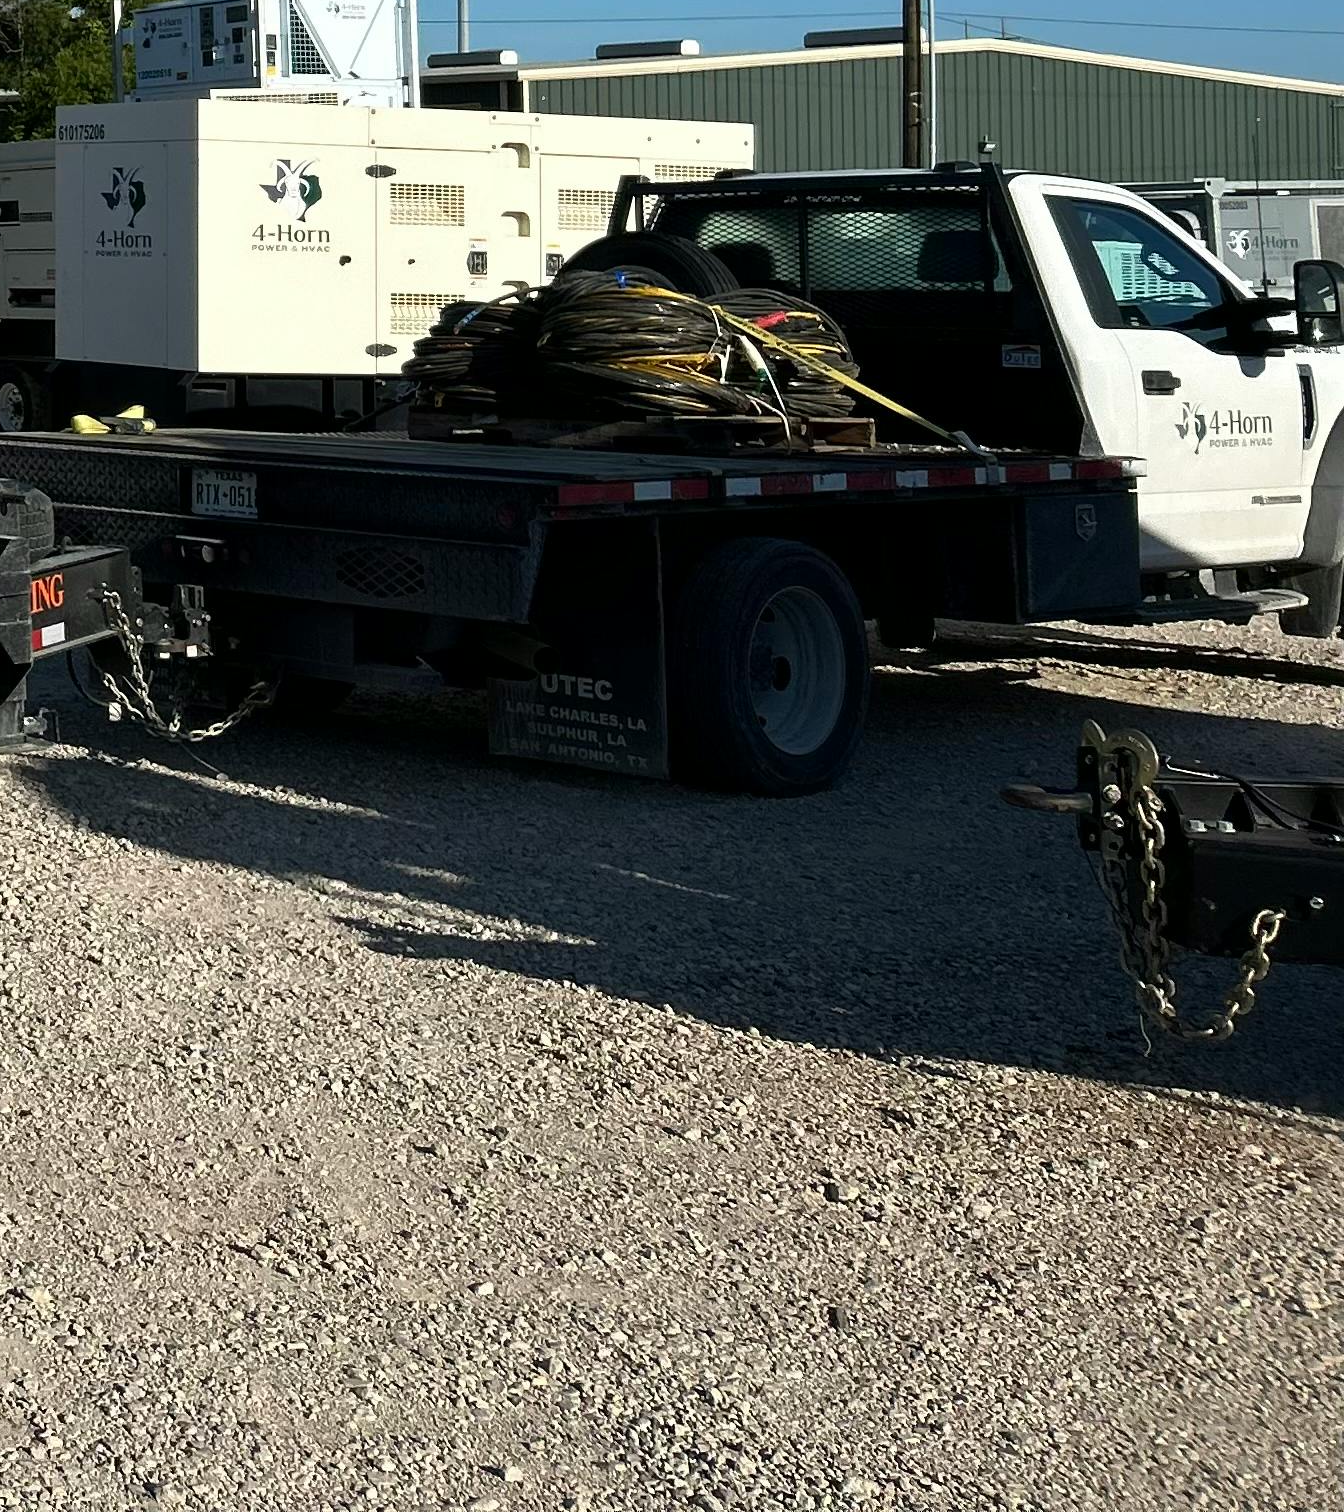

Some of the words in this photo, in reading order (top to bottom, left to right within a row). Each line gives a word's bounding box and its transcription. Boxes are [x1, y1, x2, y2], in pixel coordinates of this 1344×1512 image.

[58, 124, 105, 140] 610175206
[96, 230, 152, 248] 4-Horn
[252, 224, 330, 243] 4-Horn
[1252, 235, 1299, 249] 4-Horn
[1209, 409, 1273, 435] 4-Horn
[1210, 439, 1239, 448] POWER
[1250, 438, 1273, 447] HVAC
[215, 472, 243, 482] TEXAS
[196, 483, 257, 509] RTX-051
[30, 572, 64, 614] ING
[506, 700, 546, 716] LAKE
[550, 706, 623, 730] CHARLES,
[627, 717, 647, 731] LA
[528, 722, 602, 748] SULPHUR,
[607, 733, 627, 747] LA
[510, 738, 540, 753] SAN
[547, 744, 620, 767] ANTONIO,
[627, 754, 648, 769] TX
